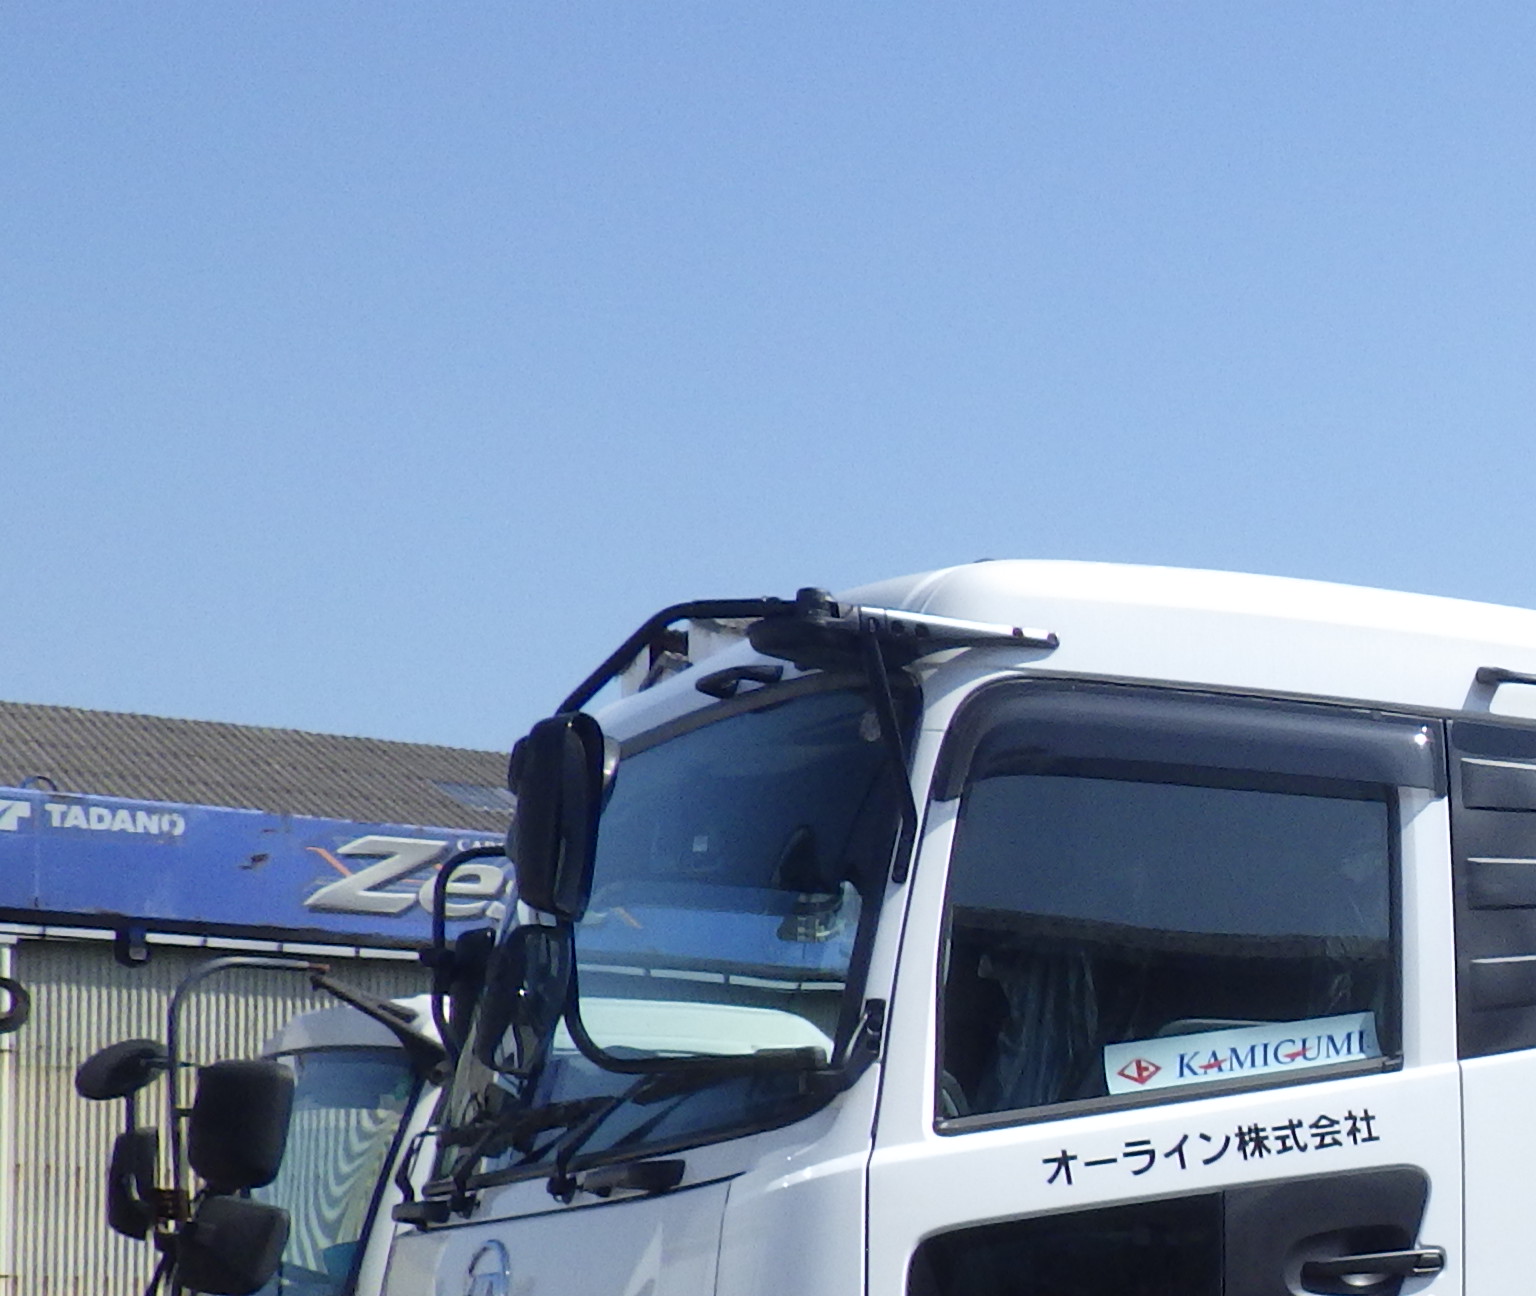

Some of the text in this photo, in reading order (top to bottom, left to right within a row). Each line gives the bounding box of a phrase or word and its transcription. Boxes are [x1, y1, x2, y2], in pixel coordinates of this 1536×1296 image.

[44, 803, 186, 836] TADANO
[1177, 1030, 1366, 1079] KAMIGUMI
[1042, 1109, 1380, 1185] オーライン株式会社
